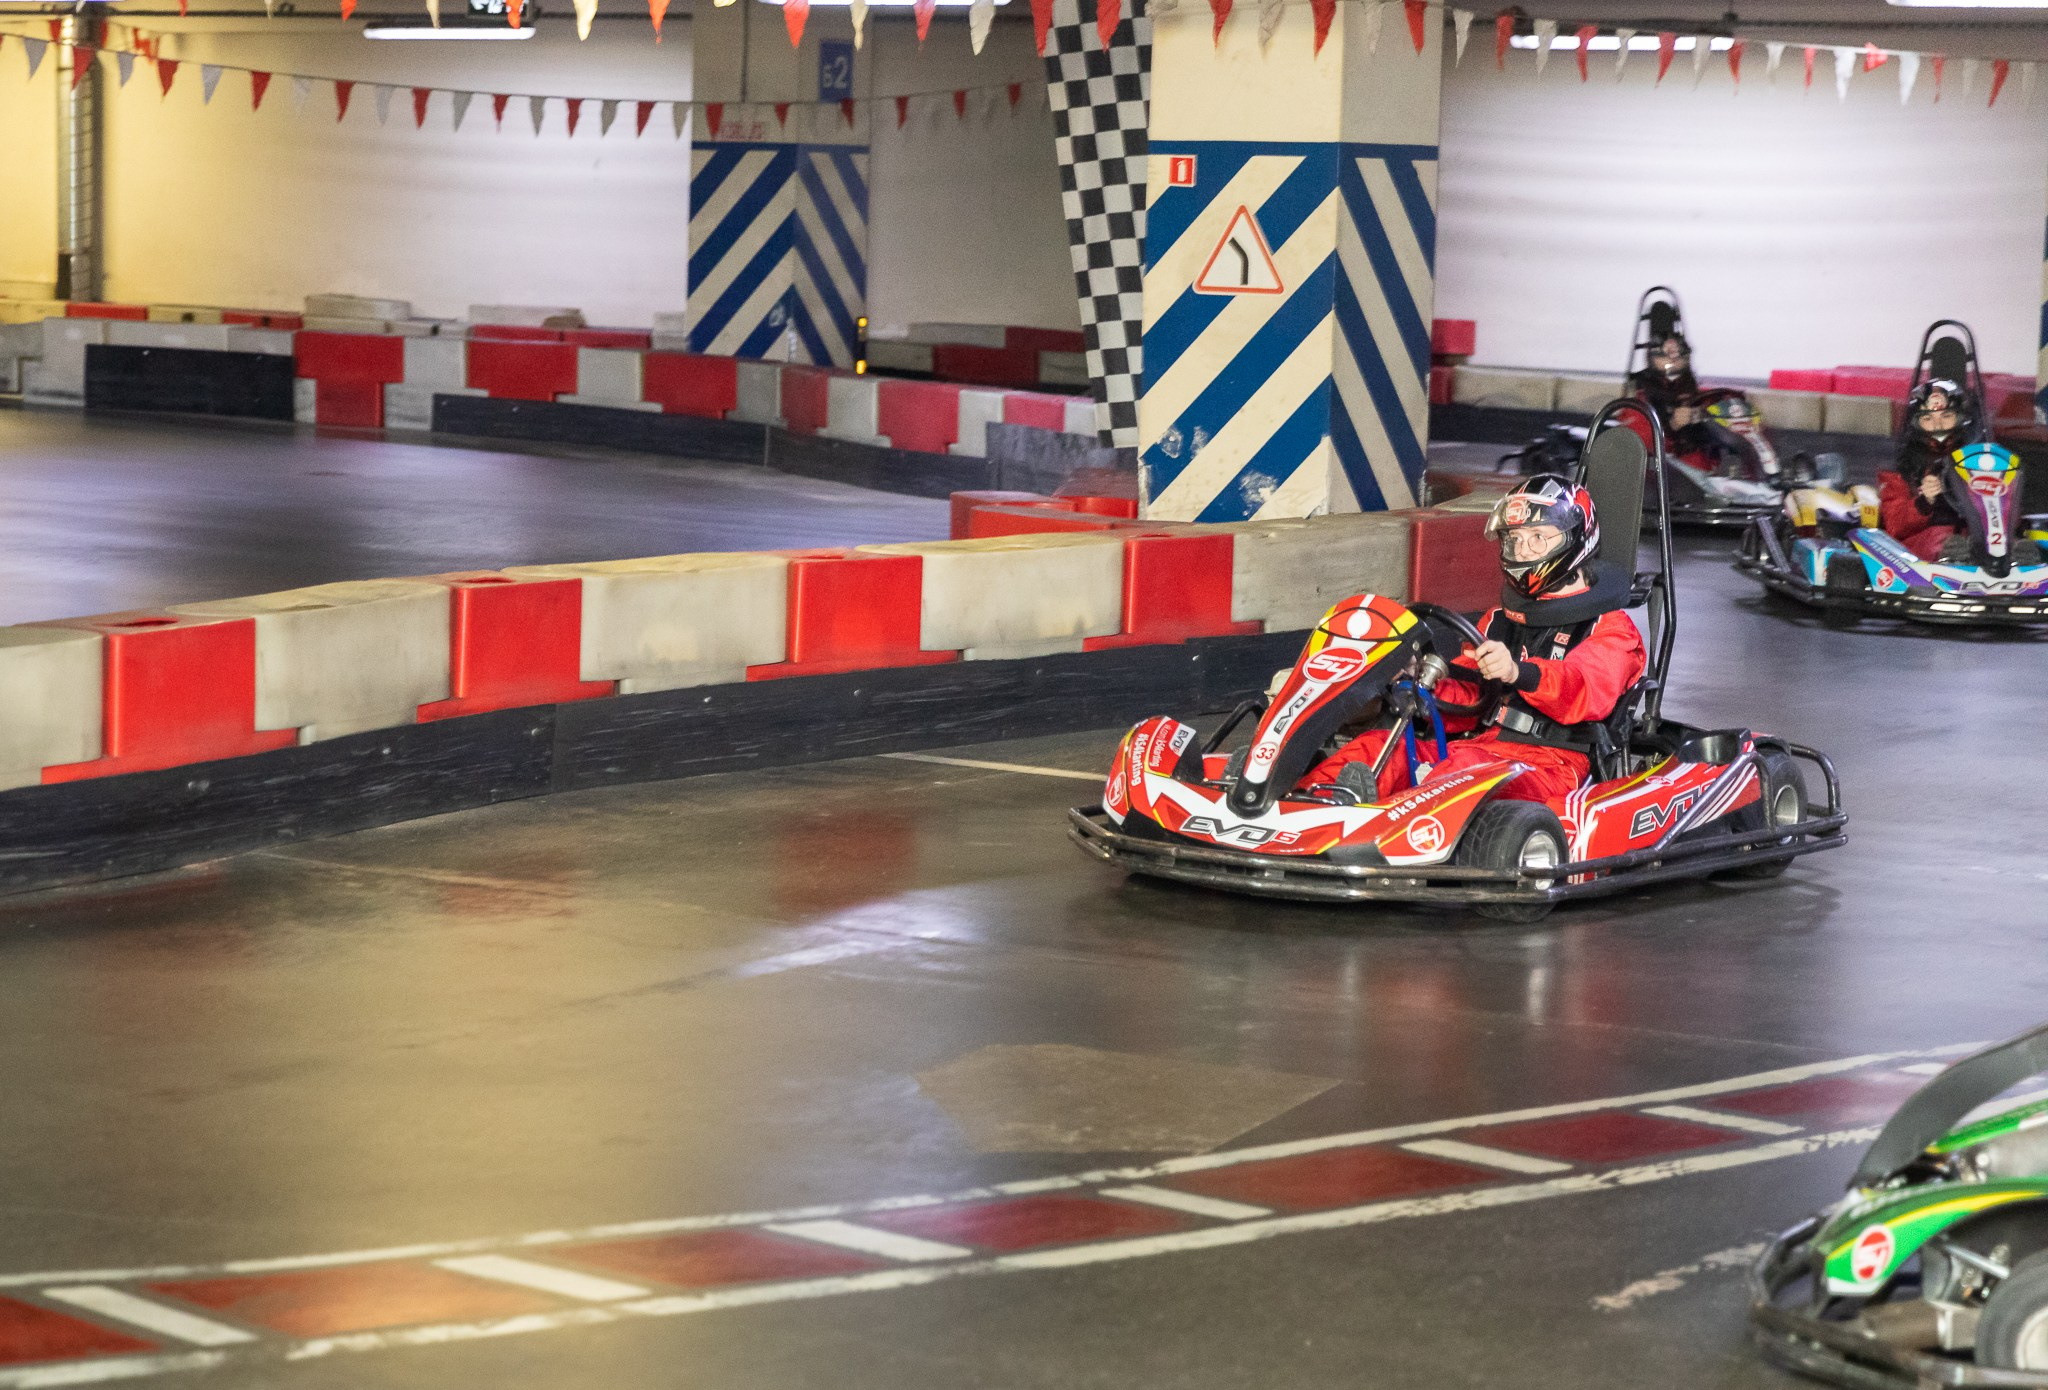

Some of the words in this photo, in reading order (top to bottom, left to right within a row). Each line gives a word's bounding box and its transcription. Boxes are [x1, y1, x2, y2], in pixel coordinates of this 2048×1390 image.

[1991, 534, 2002, 545] 2
[1256, 747, 1276, 760] 33
[1387, 774, 1475, 822] #k54karting
